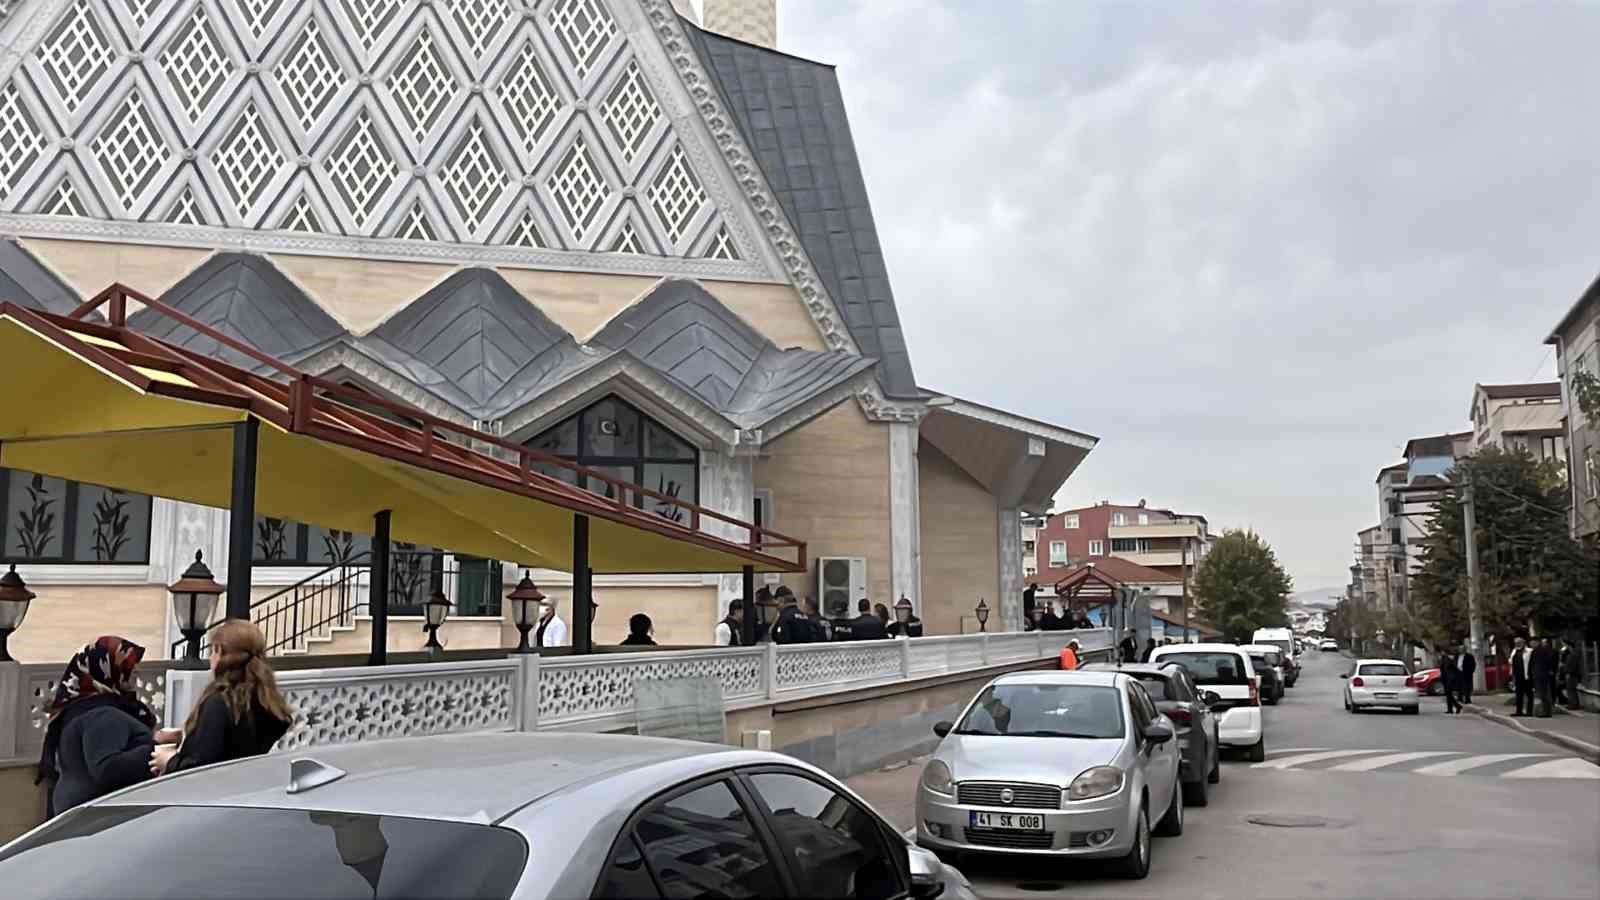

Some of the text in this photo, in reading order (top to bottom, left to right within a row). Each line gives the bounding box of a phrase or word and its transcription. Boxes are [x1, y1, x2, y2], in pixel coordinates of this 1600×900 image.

[979, 813, 991, 826] 41
[1000, 815, 1013, 827] SK
[1019, 816, 1040, 828] 008
